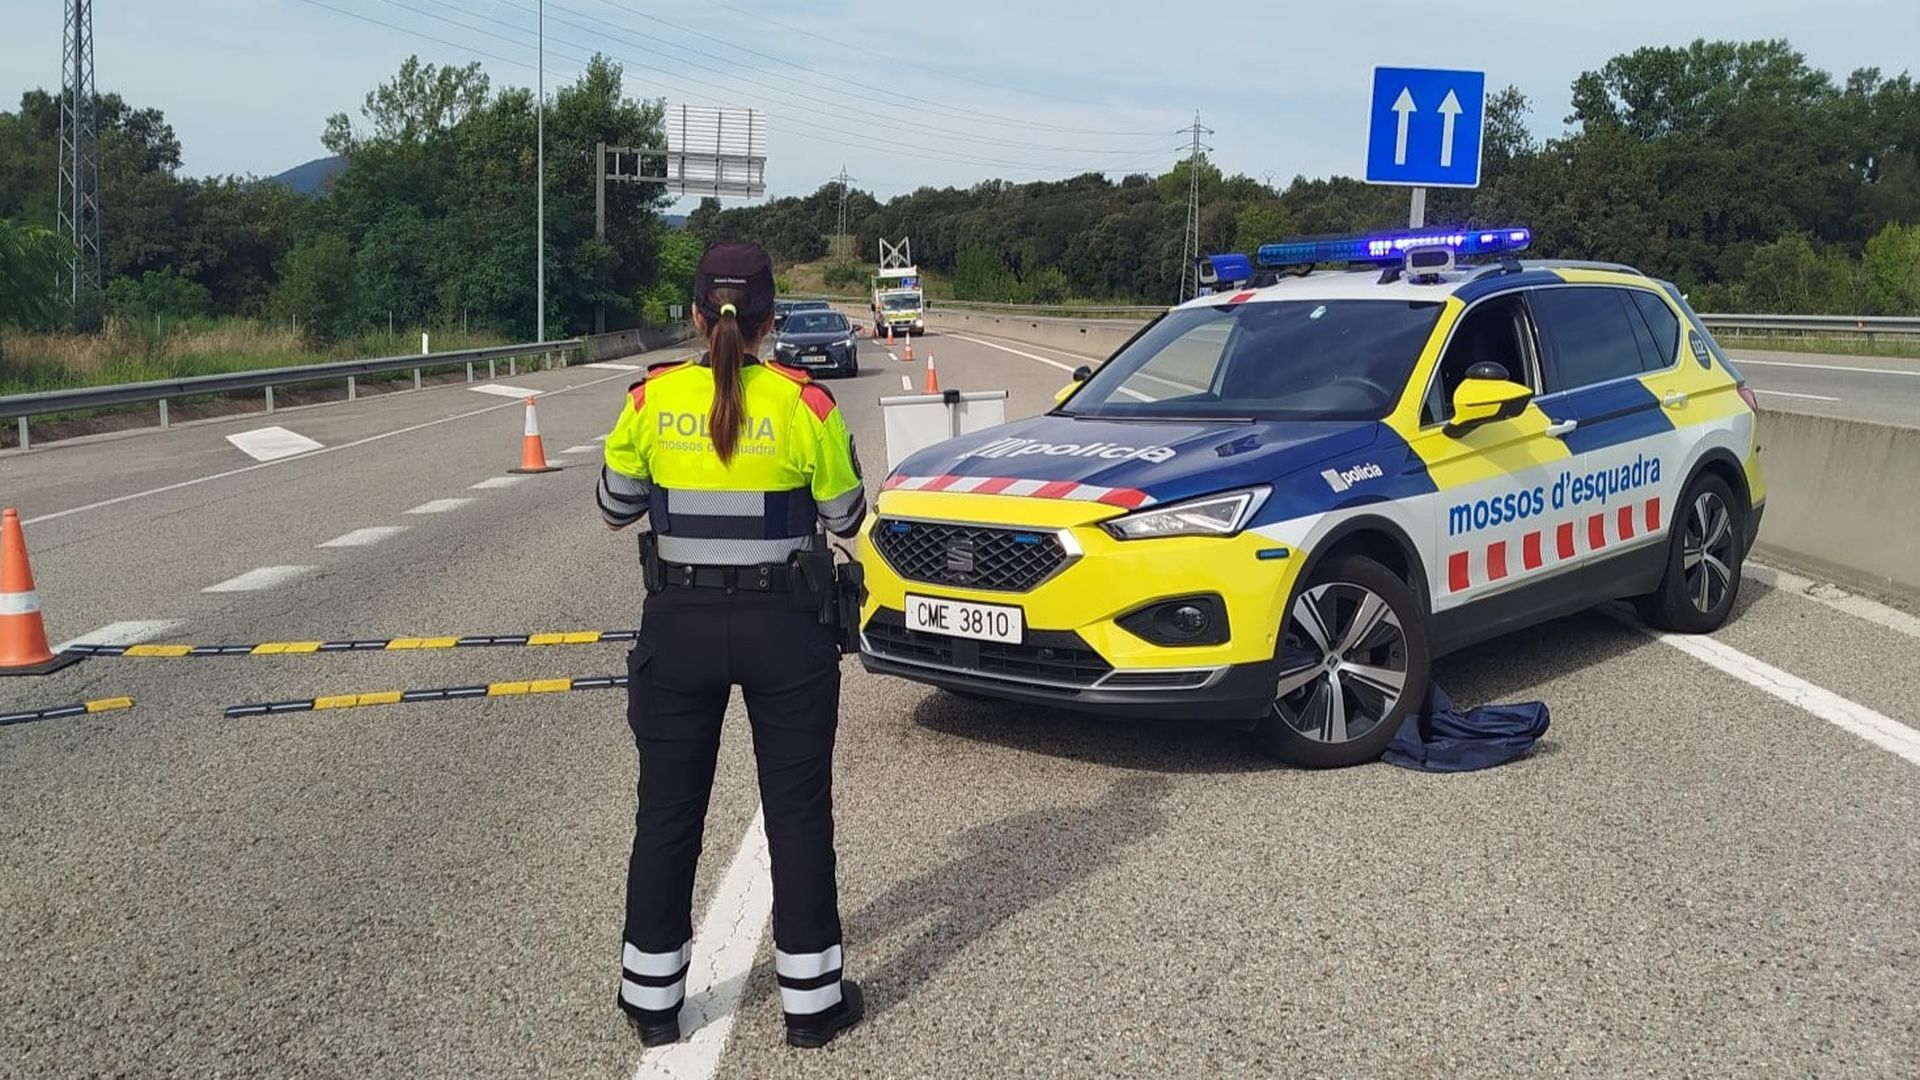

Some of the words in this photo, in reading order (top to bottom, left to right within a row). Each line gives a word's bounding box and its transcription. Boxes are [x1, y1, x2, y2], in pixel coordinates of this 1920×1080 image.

[657, 412, 776, 441] POLIA
[659, 440, 703, 452] mossos
[1006, 440, 1177, 463] policia
[1340, 462, 1384, 487] policia
[1449, 486, 1545, 536] mossos
[1551, 453, 1661, 510] d'esquadra
[917, 602, 950, 630] CME
[960, 608, 1008, 637] 3810
